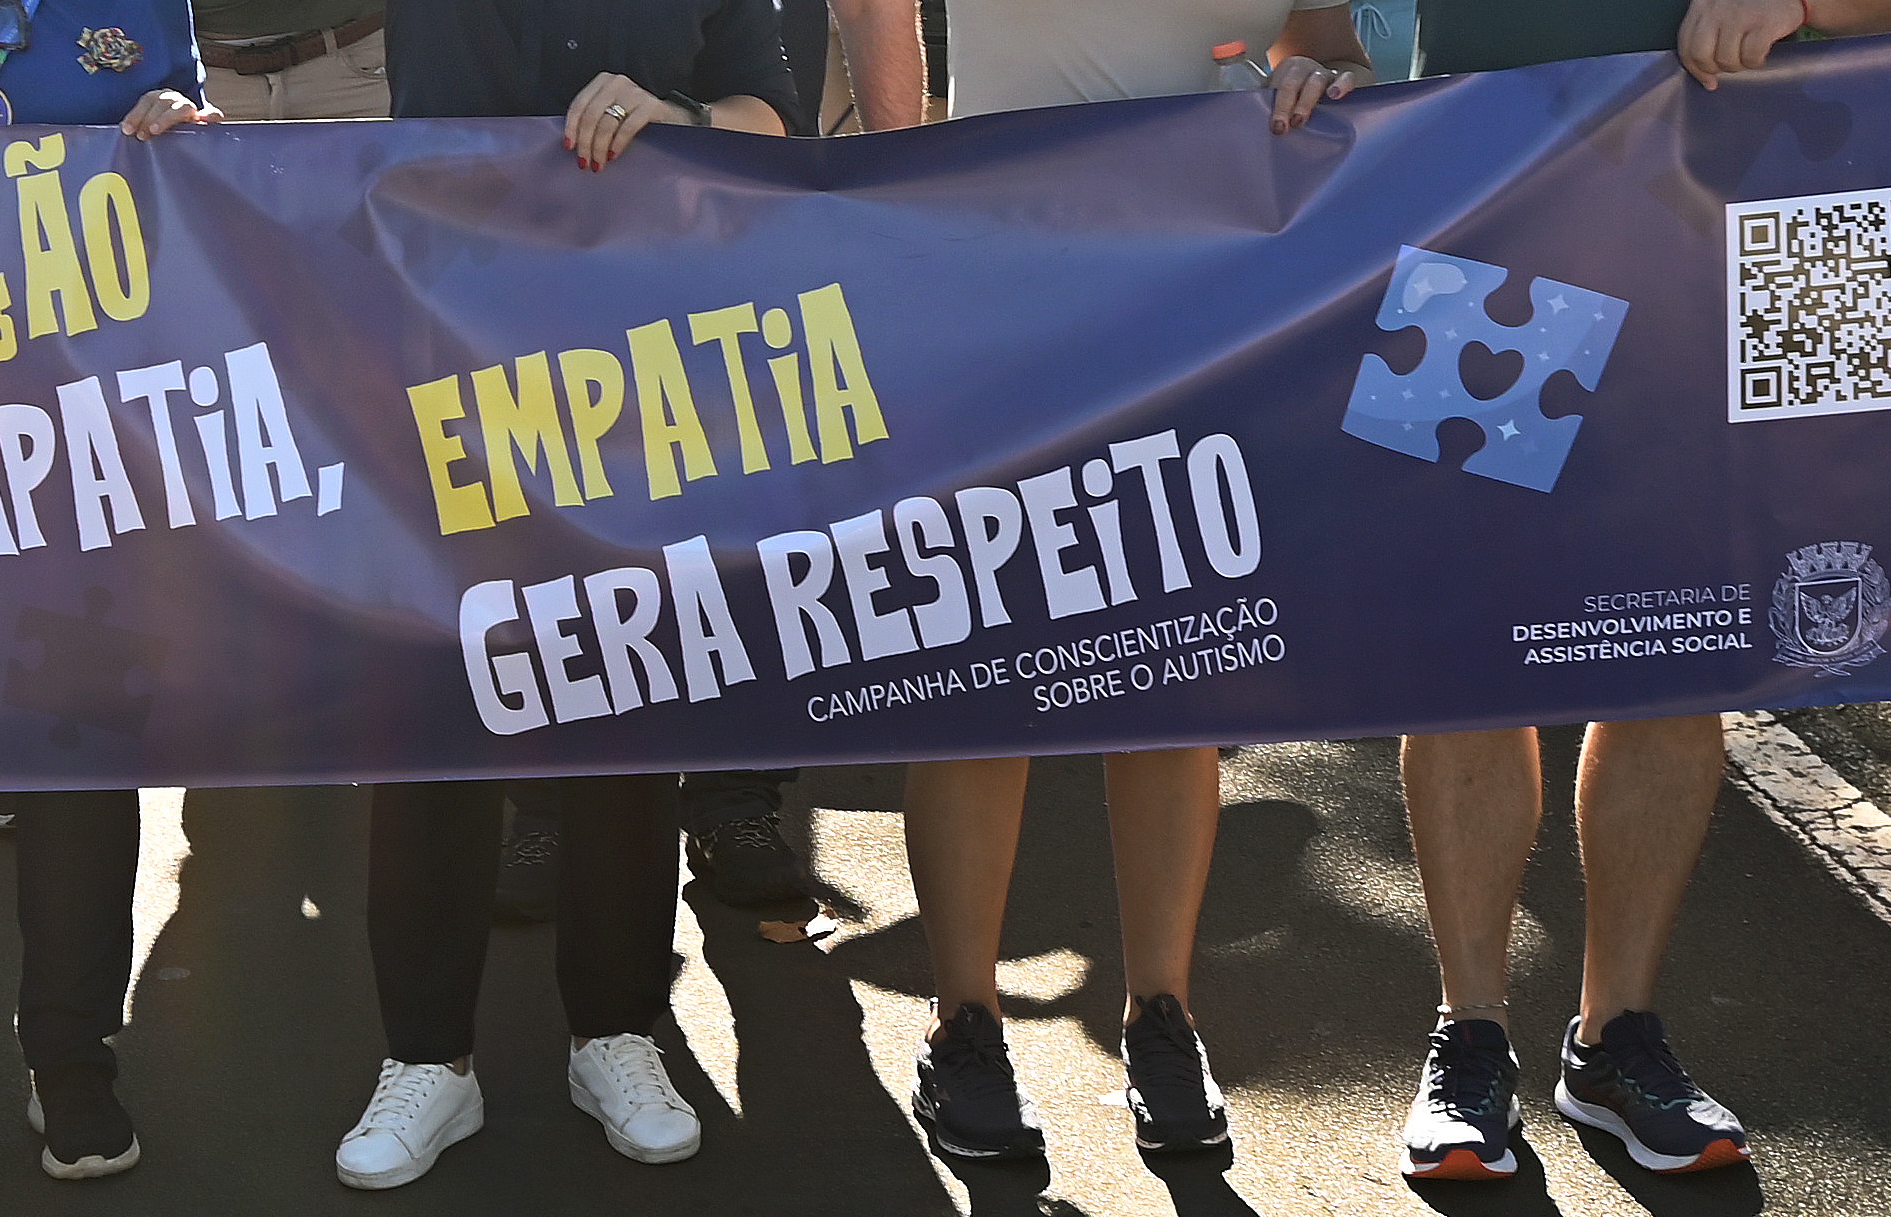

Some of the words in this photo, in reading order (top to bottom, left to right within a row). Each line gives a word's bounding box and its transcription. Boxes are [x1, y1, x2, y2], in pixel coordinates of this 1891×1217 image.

[1512, 609, 1733, 643] DESENVOLVIMENTO
[1737, 607, 1752, 625] E
[1582, 586, 1717, 614] SECRETARIA
[1720, 583, 1752, 603] DE
[457, 533, 757, 737] GERA
[806, 667, 969, 723] CAMPANHA
[968, 657, 1011, 691] DE
[1013, 596, 1279, 680] CONSCIENTIZAÇÃO
[1523, 639, 1667, 666] ASSISTÊNCIA
[1670, 631, 1753, 655] SOCIAL
[1032, 669, 1127, 714] SOBRE
[1128, 664, 1154, 692] O
[1161, 633, 1288, 688] AUTISMO
